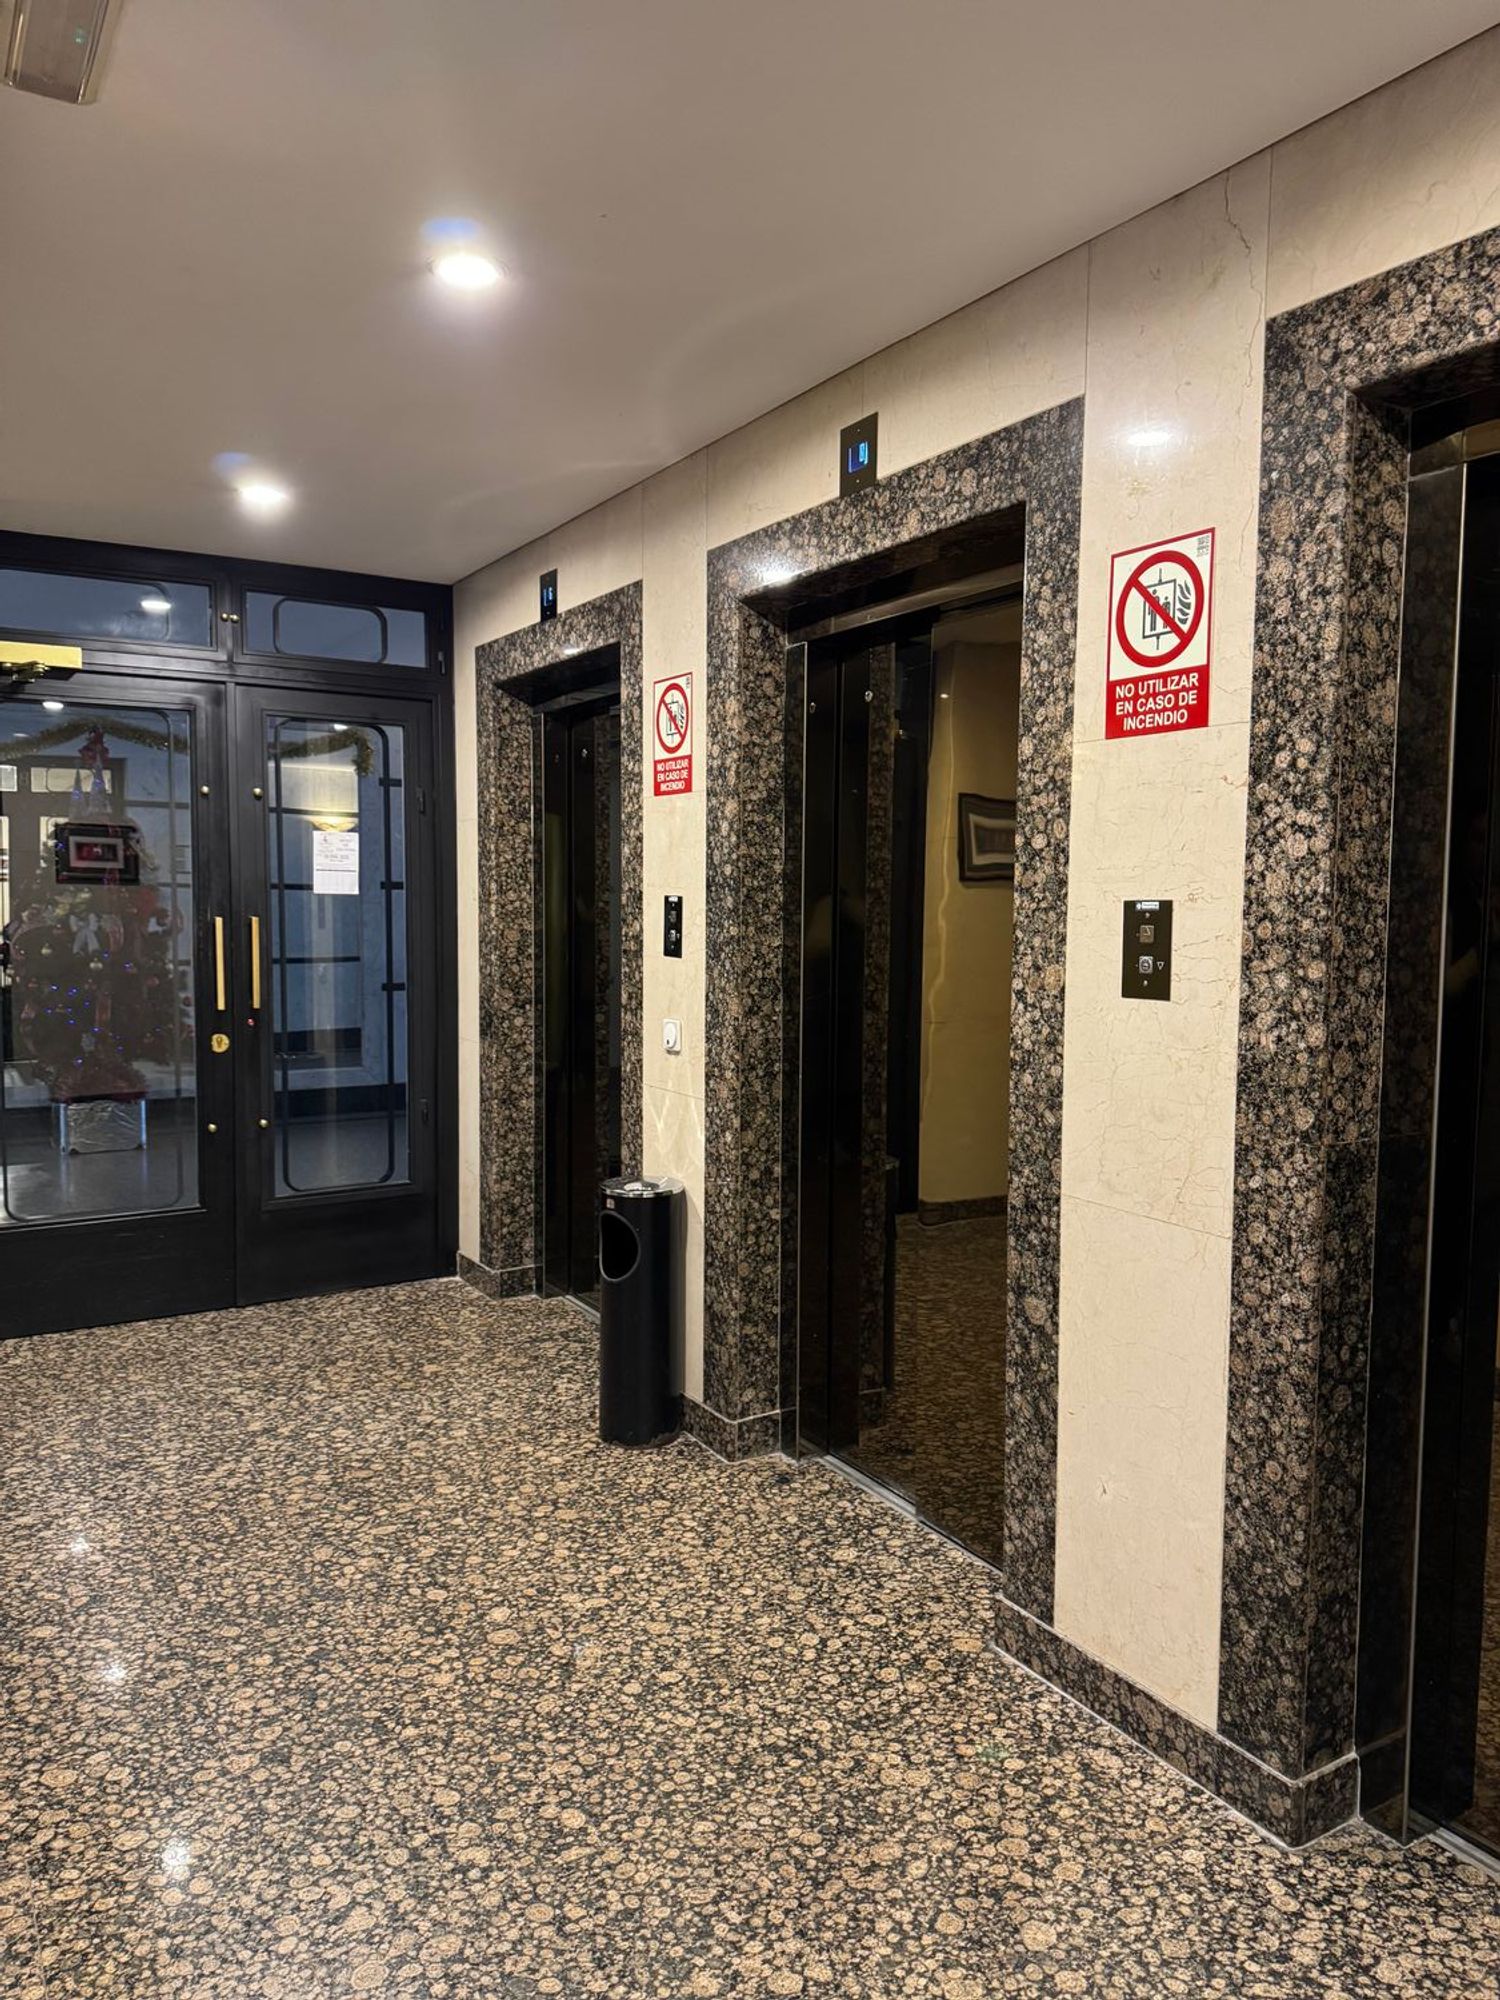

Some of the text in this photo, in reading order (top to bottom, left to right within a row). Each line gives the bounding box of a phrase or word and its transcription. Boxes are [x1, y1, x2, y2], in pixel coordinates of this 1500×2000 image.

[1116, 672, 1199, 699] NO UTILIZAR
[1116, 690, 1198, 716] EN CASO DE
[1123, 708, 1188, 731] INCENDIO
